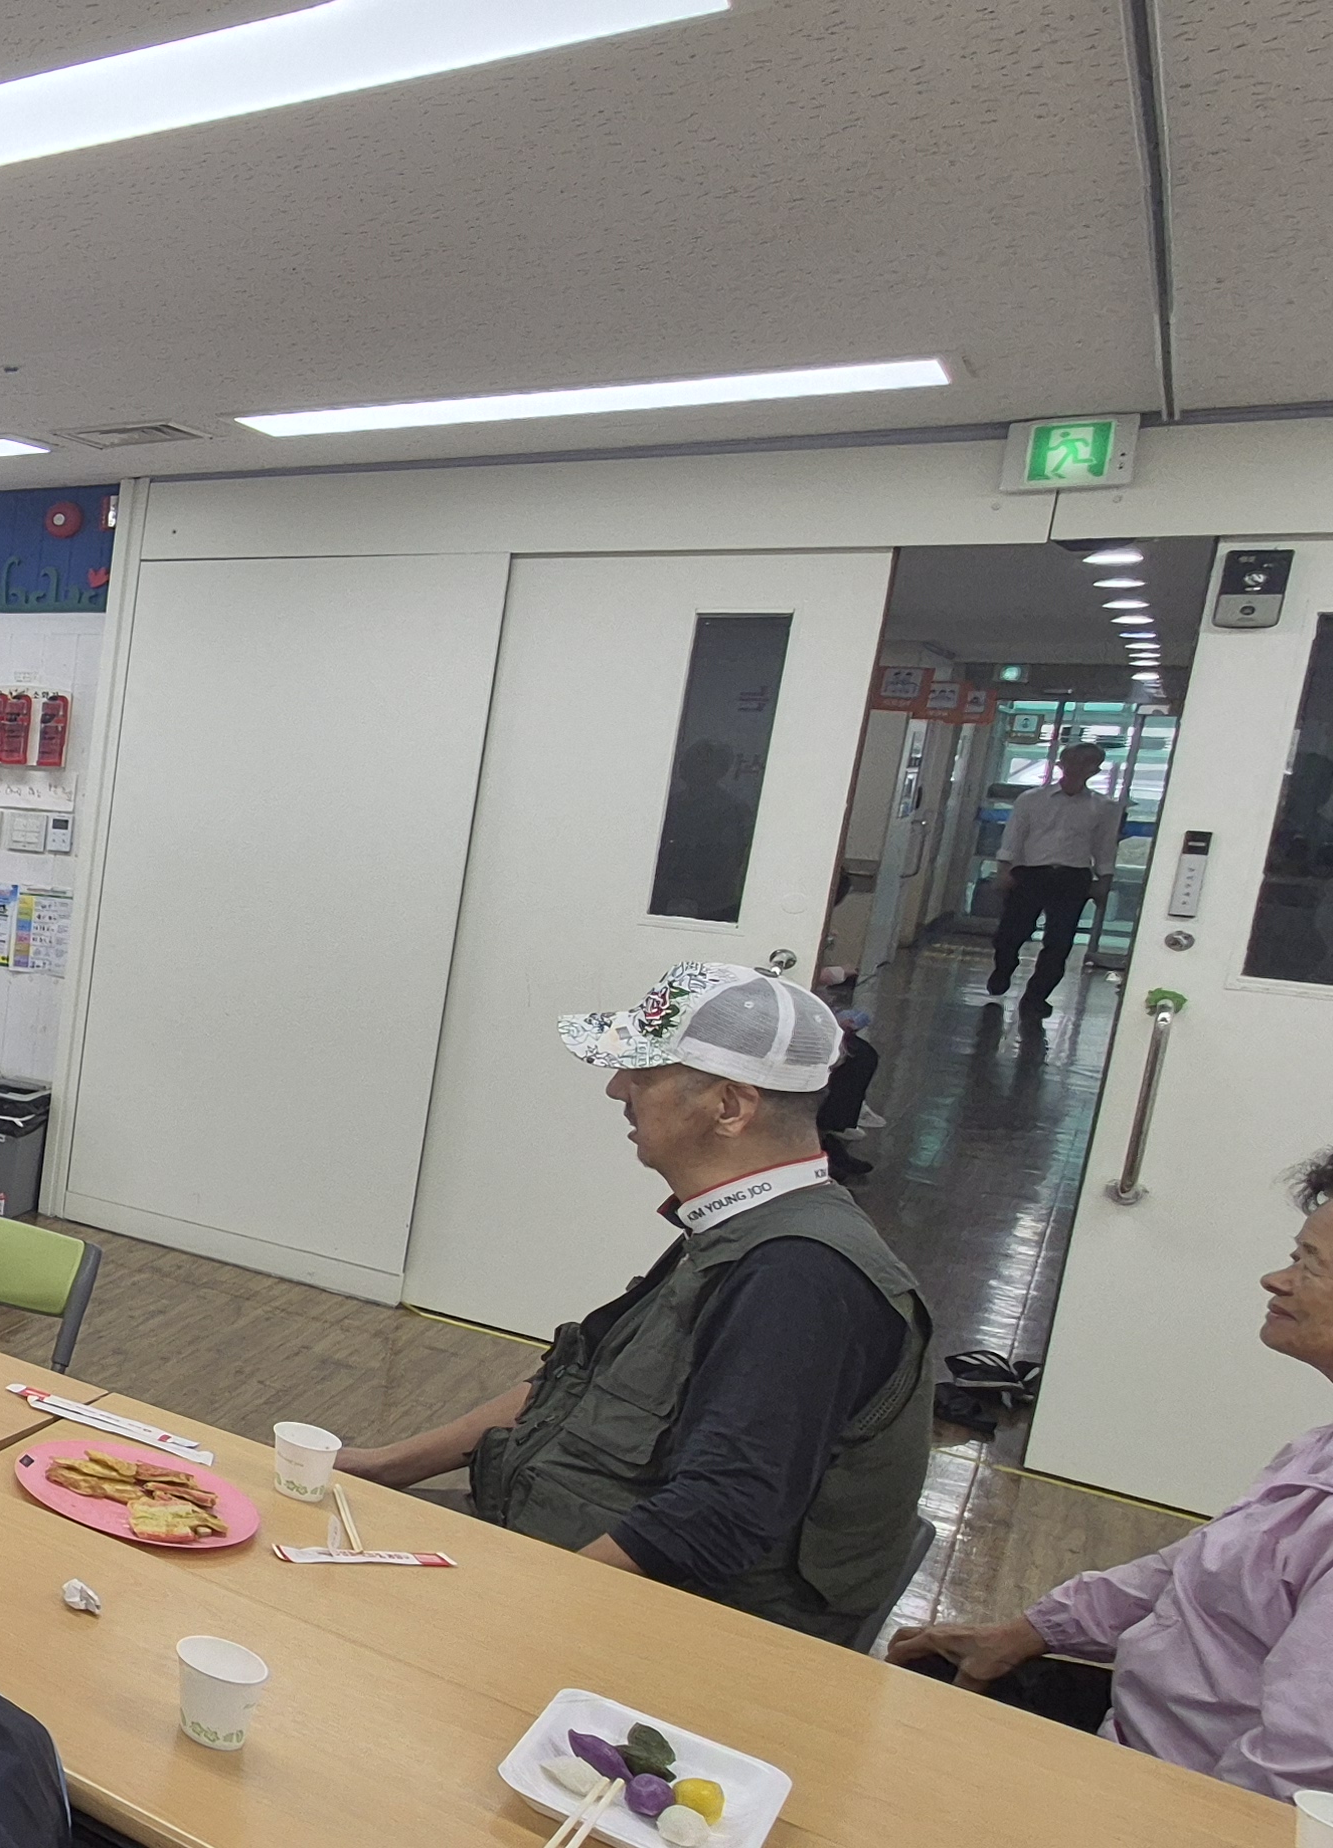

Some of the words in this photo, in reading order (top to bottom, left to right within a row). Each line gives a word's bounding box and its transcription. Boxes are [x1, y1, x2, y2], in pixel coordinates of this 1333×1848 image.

[687, 1207, 706, 1222] KIM
[704, 1191, 747, 1213] YOUNG
[747, 1182, 773, 1199] JOO
